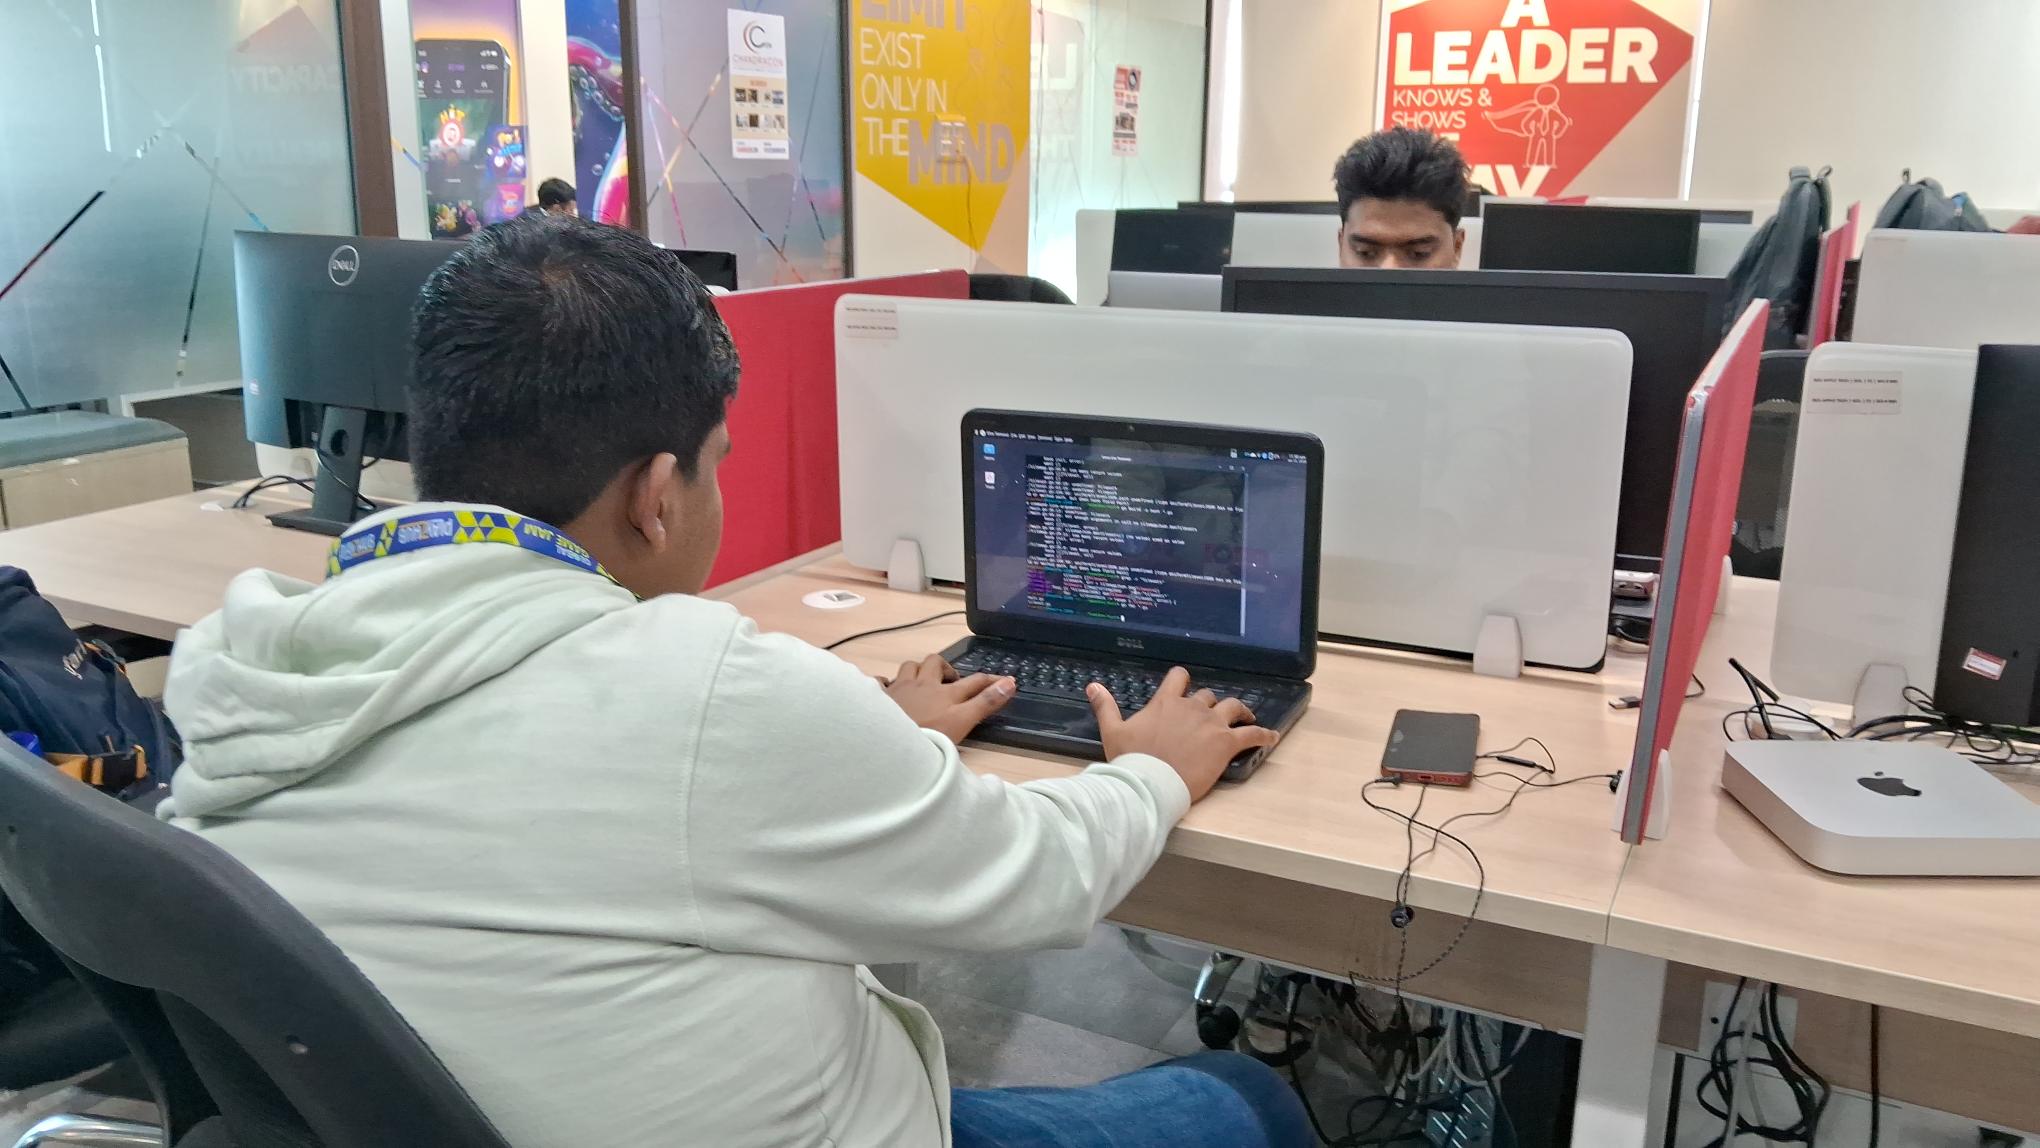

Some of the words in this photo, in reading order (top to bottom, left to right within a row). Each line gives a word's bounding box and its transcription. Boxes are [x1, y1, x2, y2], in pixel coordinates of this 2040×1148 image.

[1500, 0, 1550, 28] A
[860, 28, 926, 69] EXIST
[1393, 27, 1659, 86] LEADER
[861, 73, 922, 111] ONLY
[926, 78, 947, 113] IN
[1392, 88, 1473, 107] KNOWS
[1478, 87, 1492, 107] &
[1391, 110, 1467, 129] SHOWS
[862, 117, 910, 156] THE
[908, 119, 1016, 186] MIND
[523, 522, 554, 541] JAM
